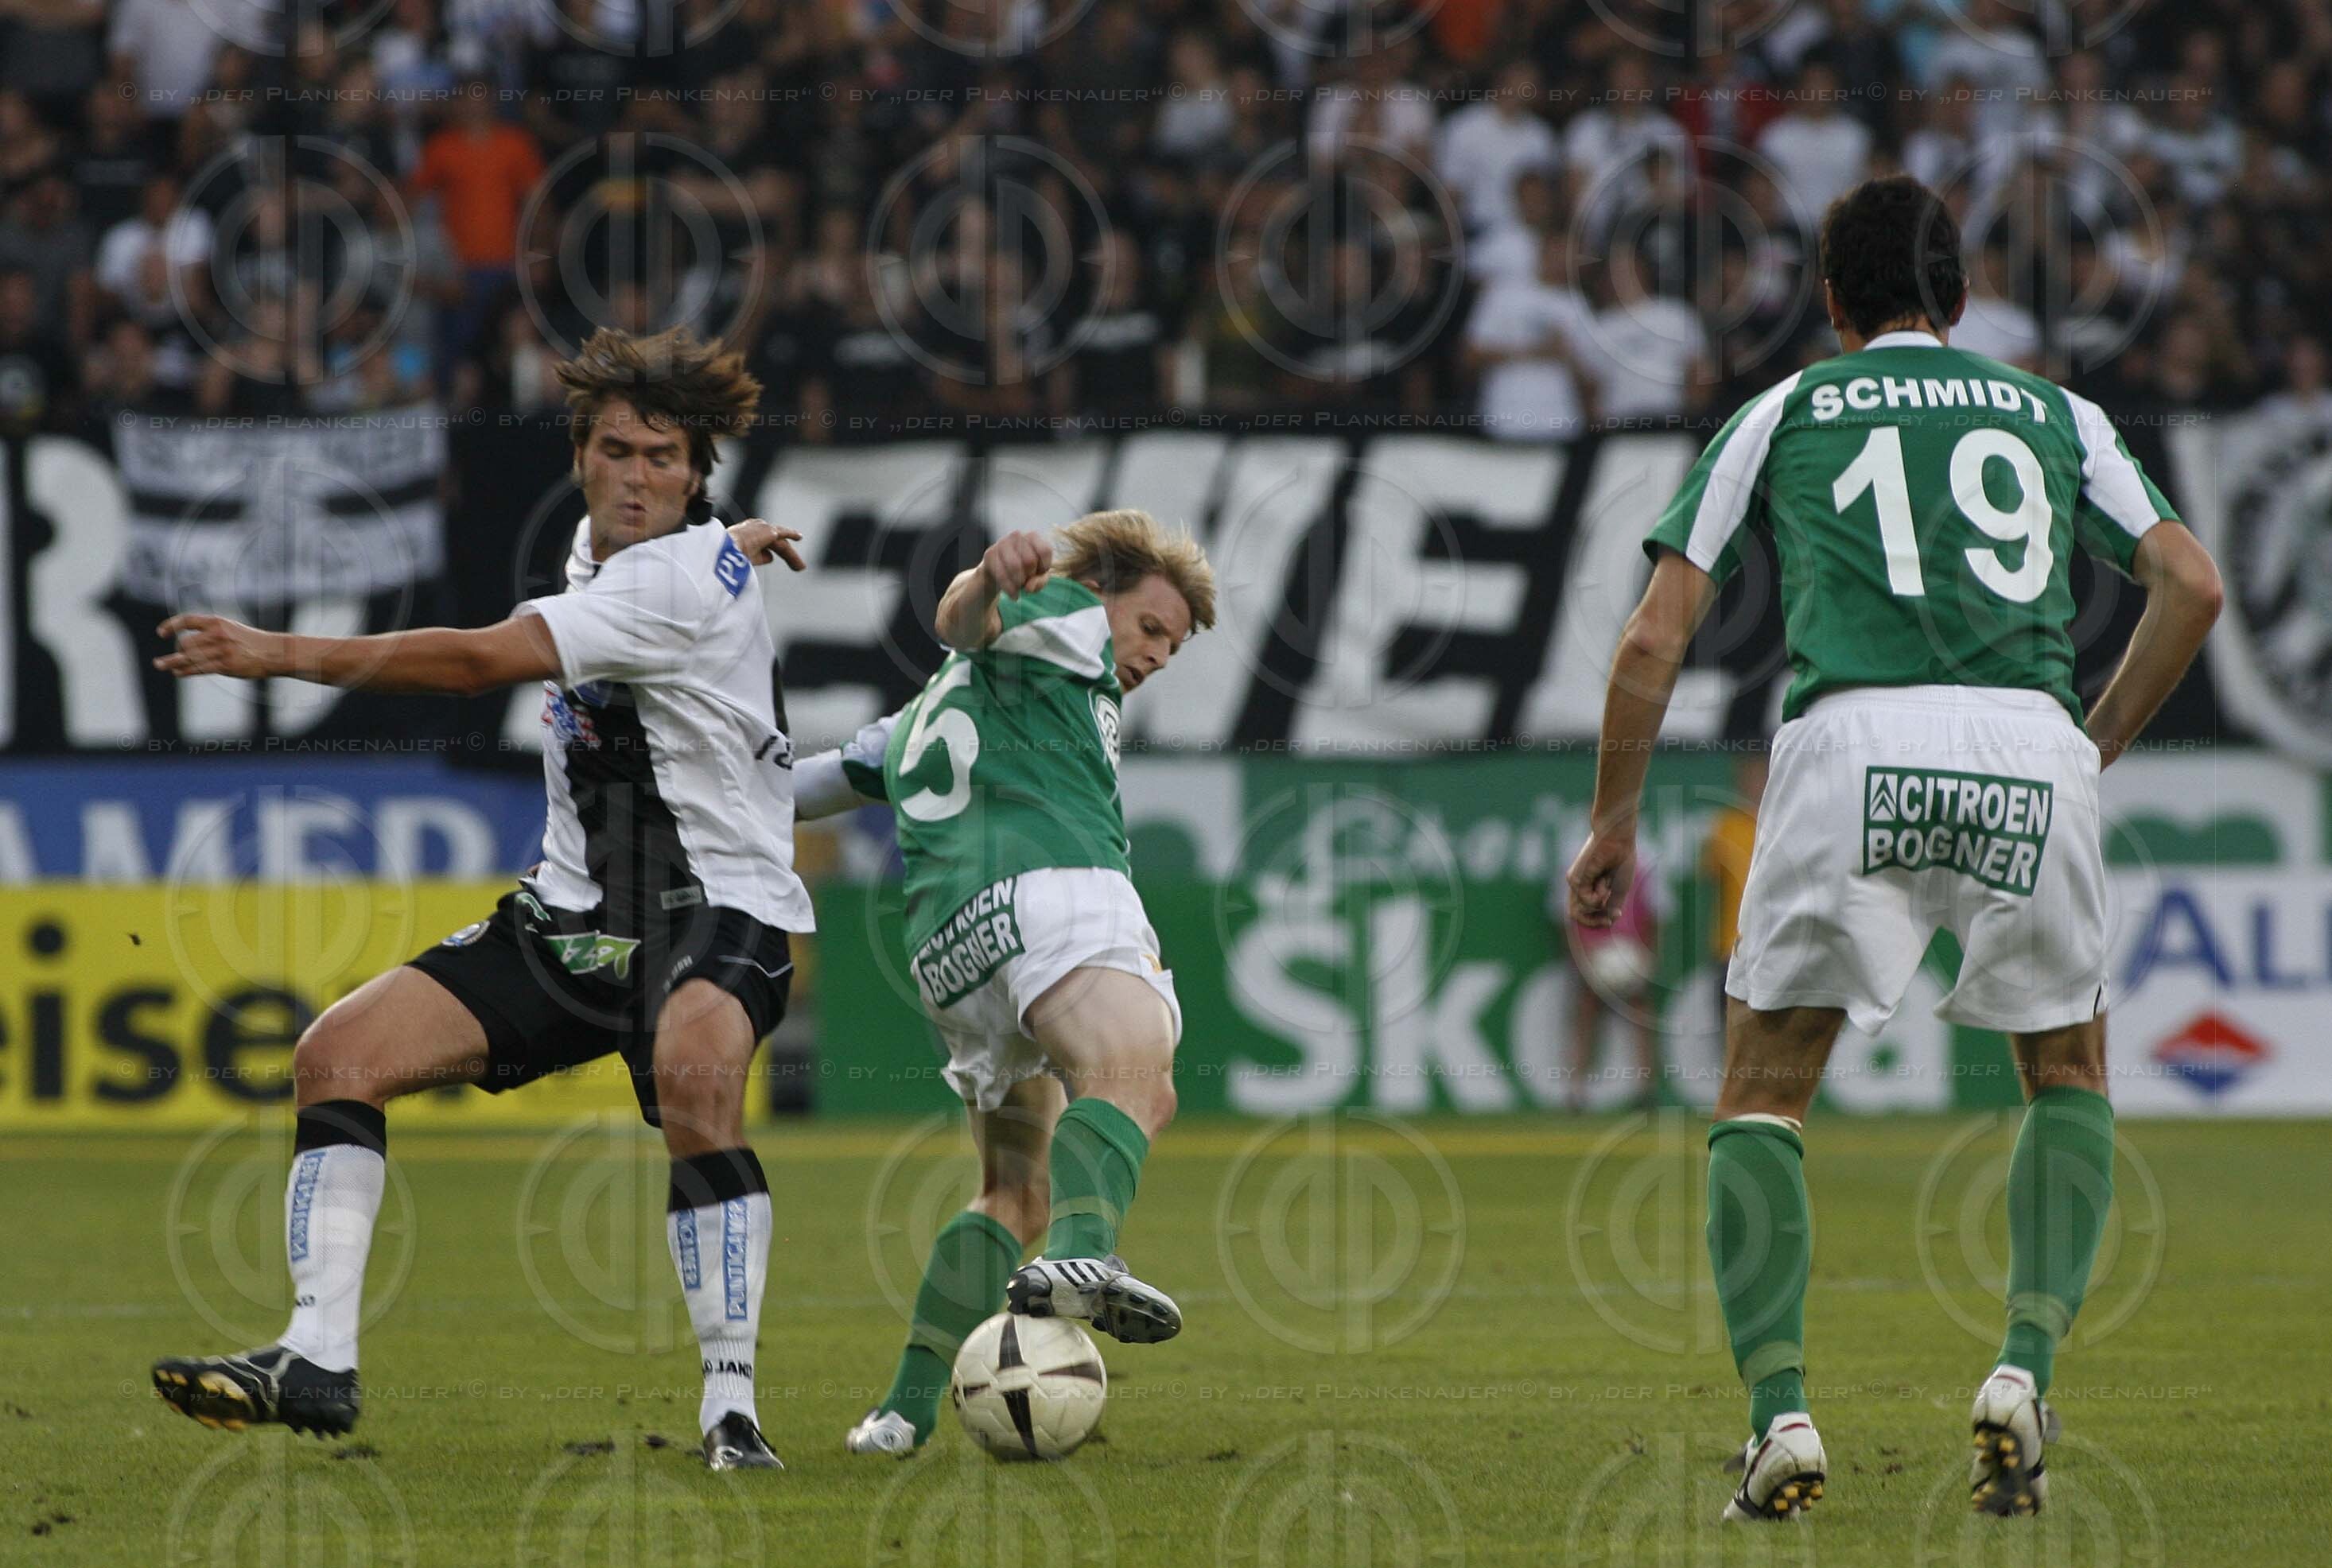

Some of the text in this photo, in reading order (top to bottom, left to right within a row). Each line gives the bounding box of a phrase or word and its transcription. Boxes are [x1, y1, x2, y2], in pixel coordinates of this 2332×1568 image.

[1812, 376, 2049, 423] SCHMIDT
[1833, 426, 2054, 603] 19
[718, 551, 748, 587] PU
[899, 659, 979, 821] 5
[1900, 774, 2049, 836] CITROEN
[1868, 825, 2038, 888] BOGNER
[923, 913, 1018, 1003] BOGNER
